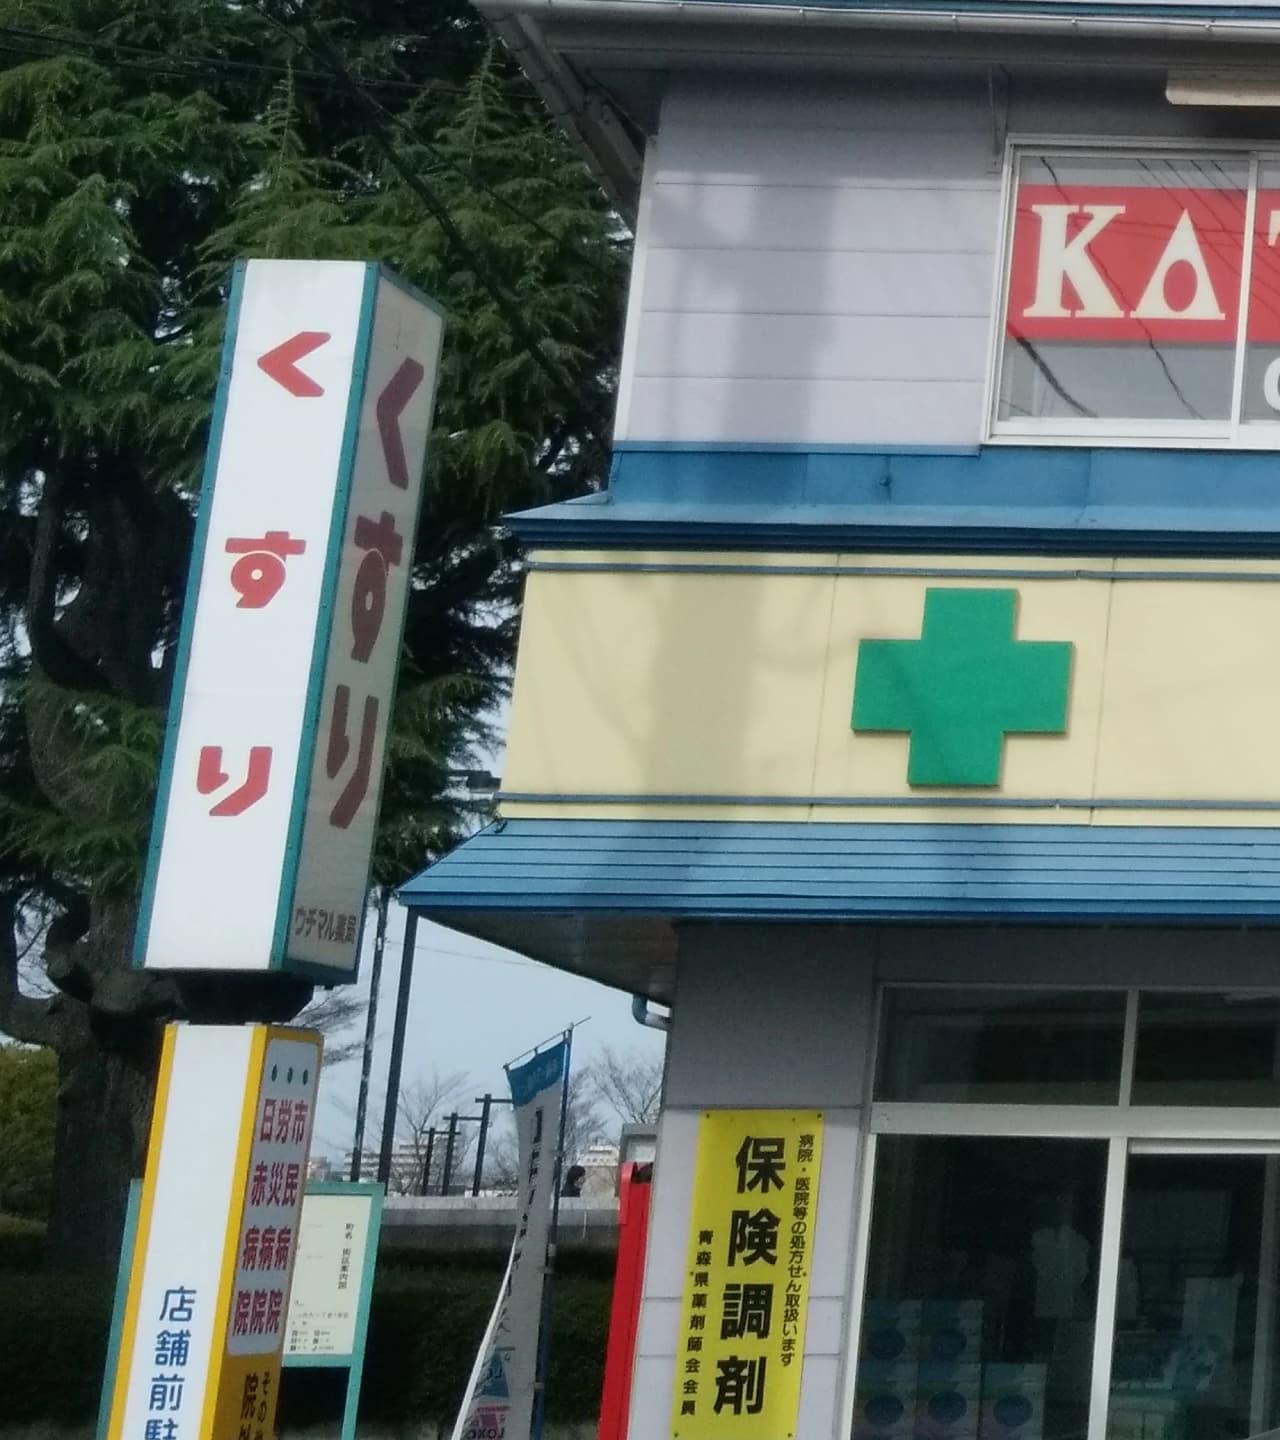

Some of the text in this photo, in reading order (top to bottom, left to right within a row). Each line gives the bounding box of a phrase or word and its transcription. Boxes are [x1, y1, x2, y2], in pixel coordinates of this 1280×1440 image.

[196, 331, 332, 817] くすり
[326, 356, 425, 830] くすり
[265, 1099, 309, 1334] 市民病院
[681, 1229, 714, 1416] 青森県薬剤師会会員
[713, 1135, 786, 1416] 保険調剤
